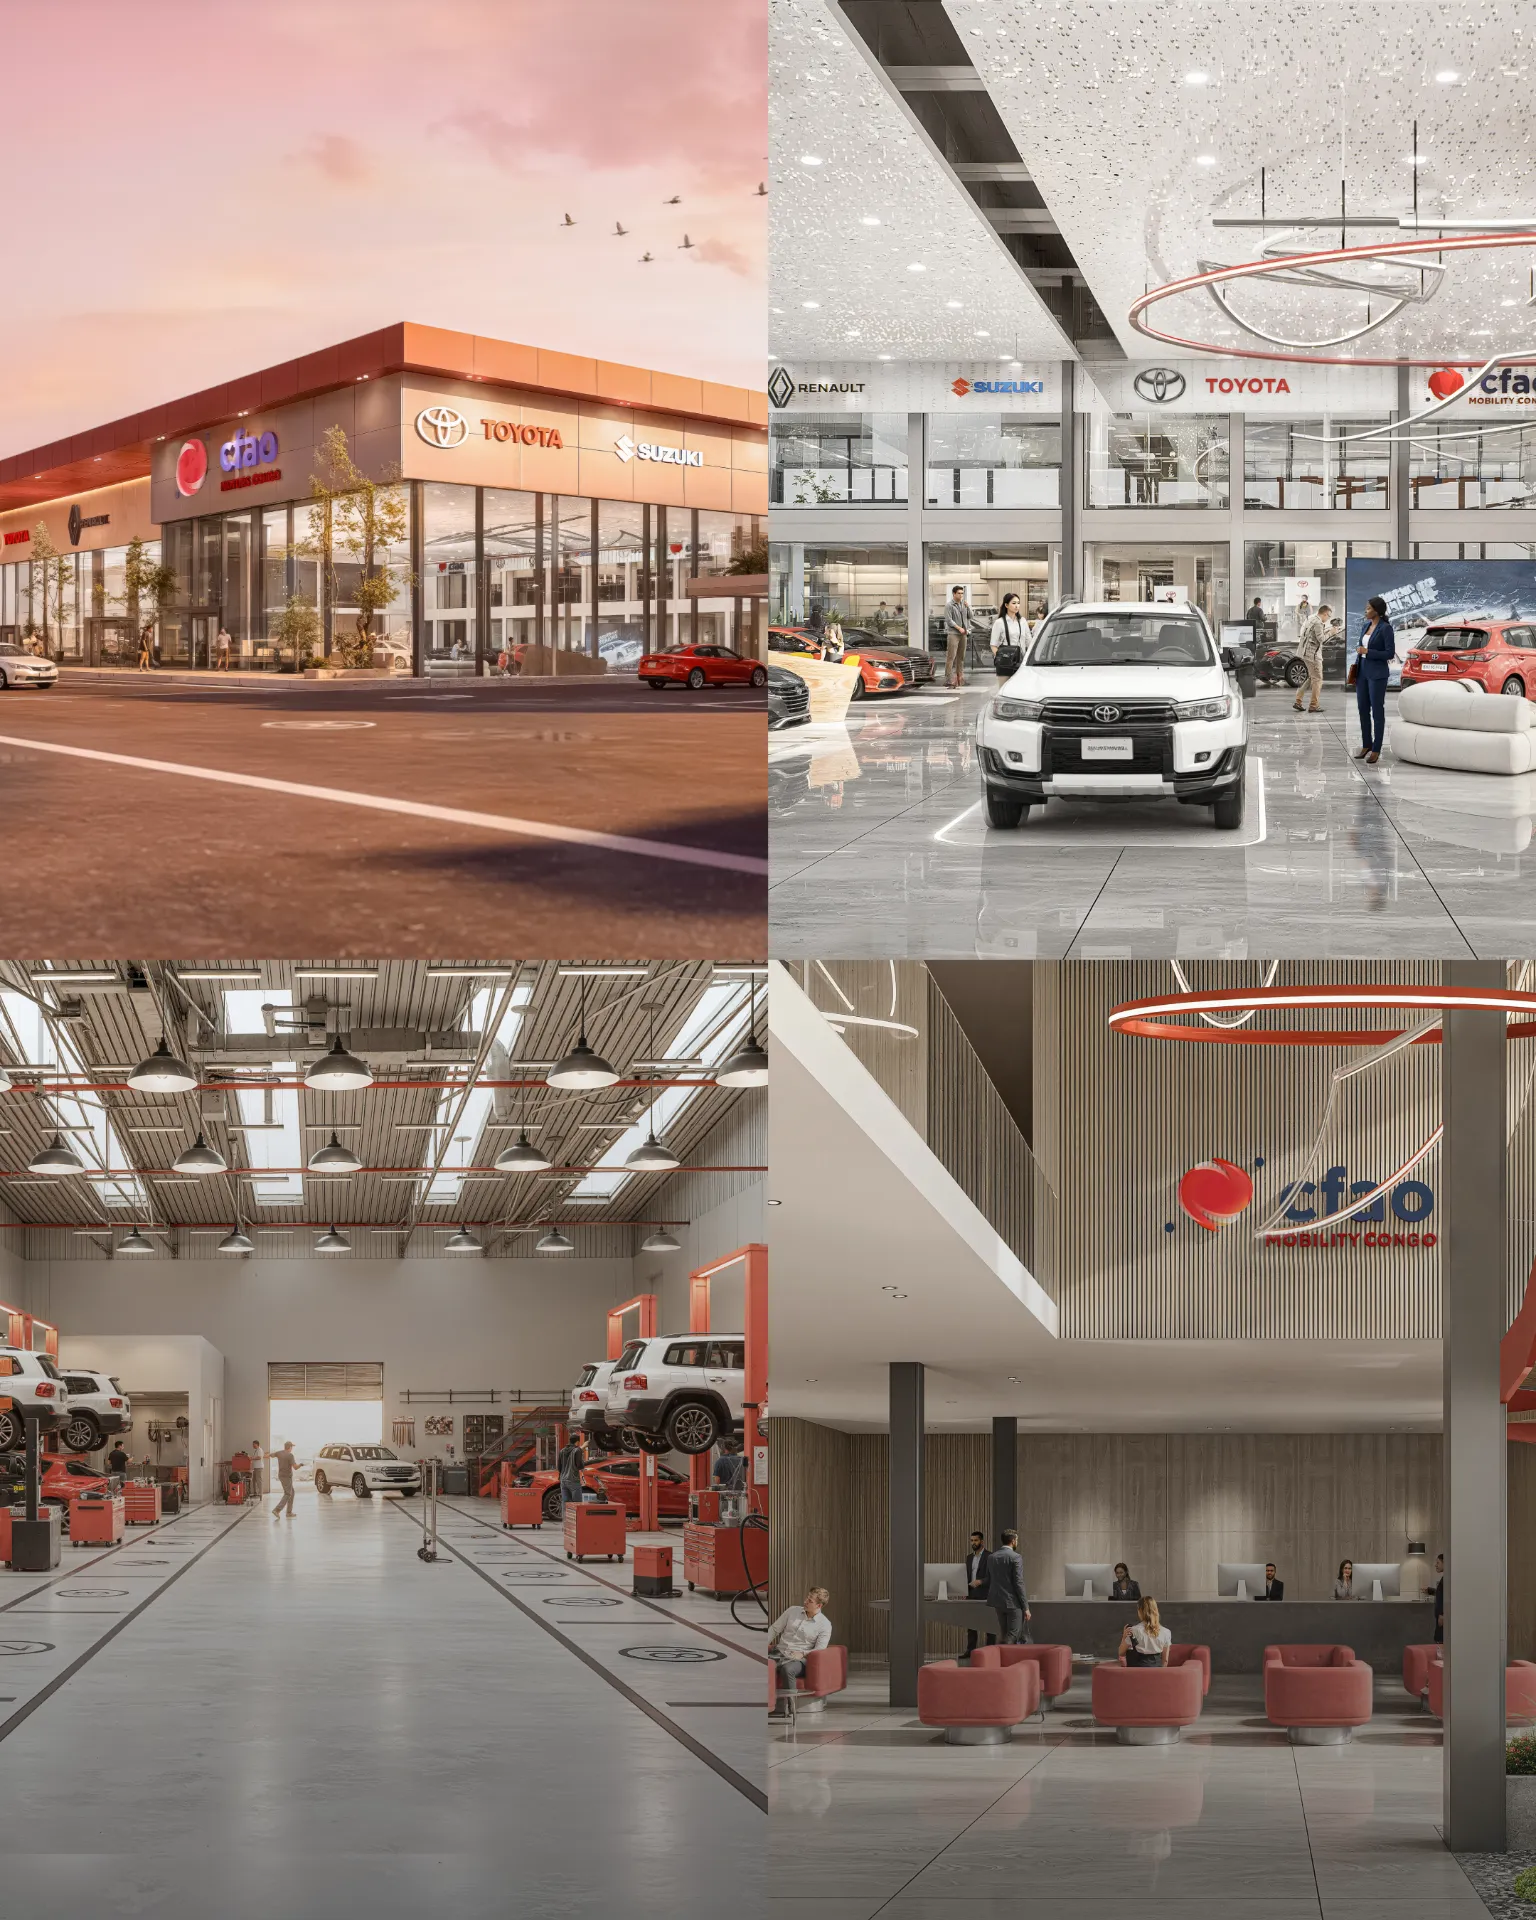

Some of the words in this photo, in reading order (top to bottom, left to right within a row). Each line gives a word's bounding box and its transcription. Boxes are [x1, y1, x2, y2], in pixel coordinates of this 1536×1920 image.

[798, 383, 866, 393] RENAULT
[973, 381, 1043, 393] SUZUKI
[1205, 378, 1291, 393] TOYOTA
[1468, 397, 1515, 405] MOBILITY
[480, 419, 563, 449] TOYOTA
[220, 427, 279, 472] cfao
[637, 443, 704, 467] SUZUKI
[1280, 1166, 1434, 1222] cfao
[1265, 1233, 1361, 1248] MOBILITY
[1363, 1231, 1437, 1248] CONGO
